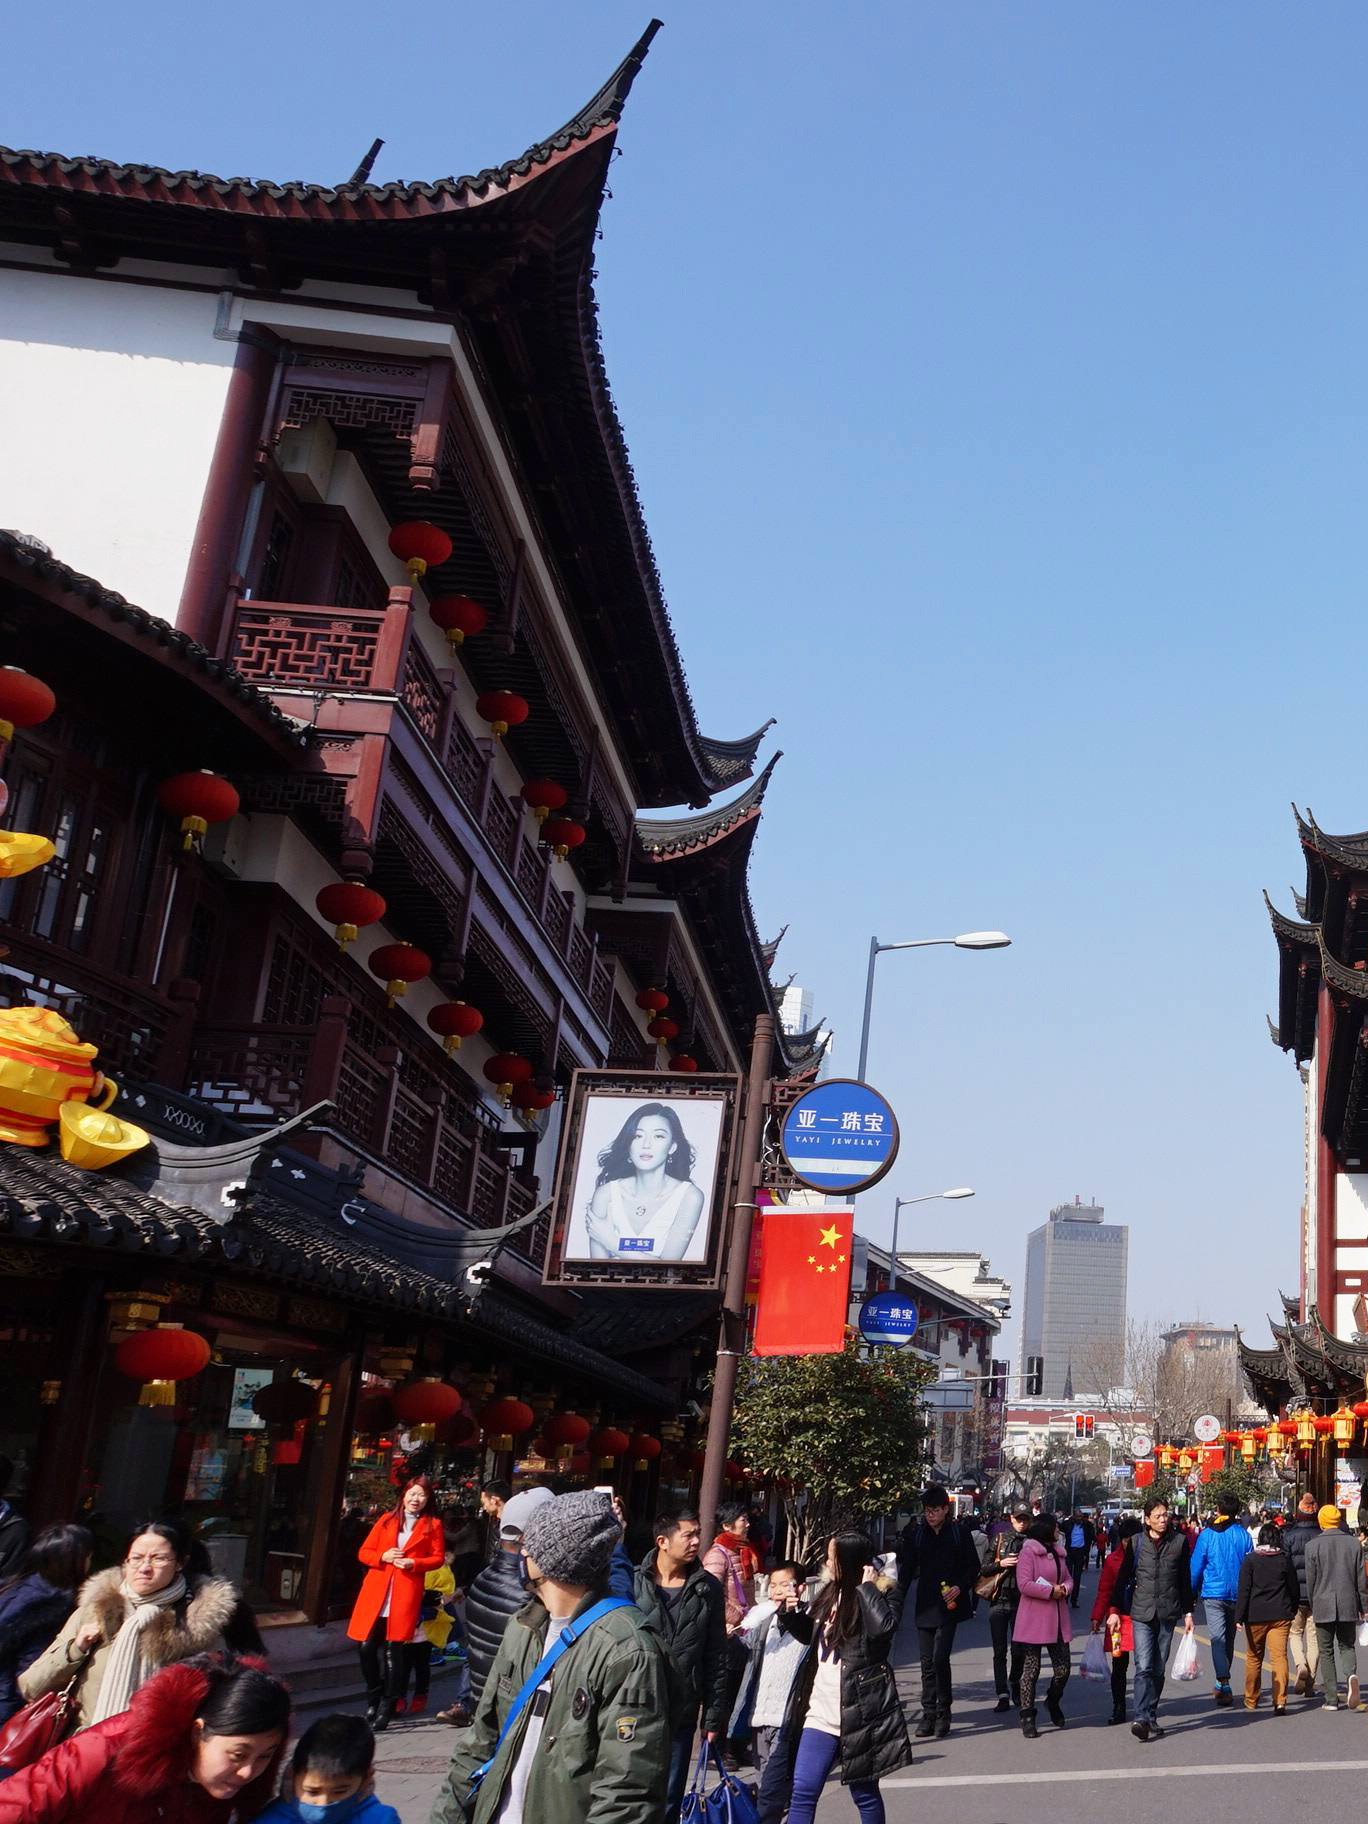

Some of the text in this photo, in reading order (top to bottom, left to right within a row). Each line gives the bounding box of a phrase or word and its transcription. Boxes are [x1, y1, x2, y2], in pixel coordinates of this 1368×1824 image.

[796, 1109, 884, 1132] 亚一珠宝
[795, 1135, 881, 1147] YAYI JEWELRY
[866, 1305, 913, 1320] 亚一珠宝
